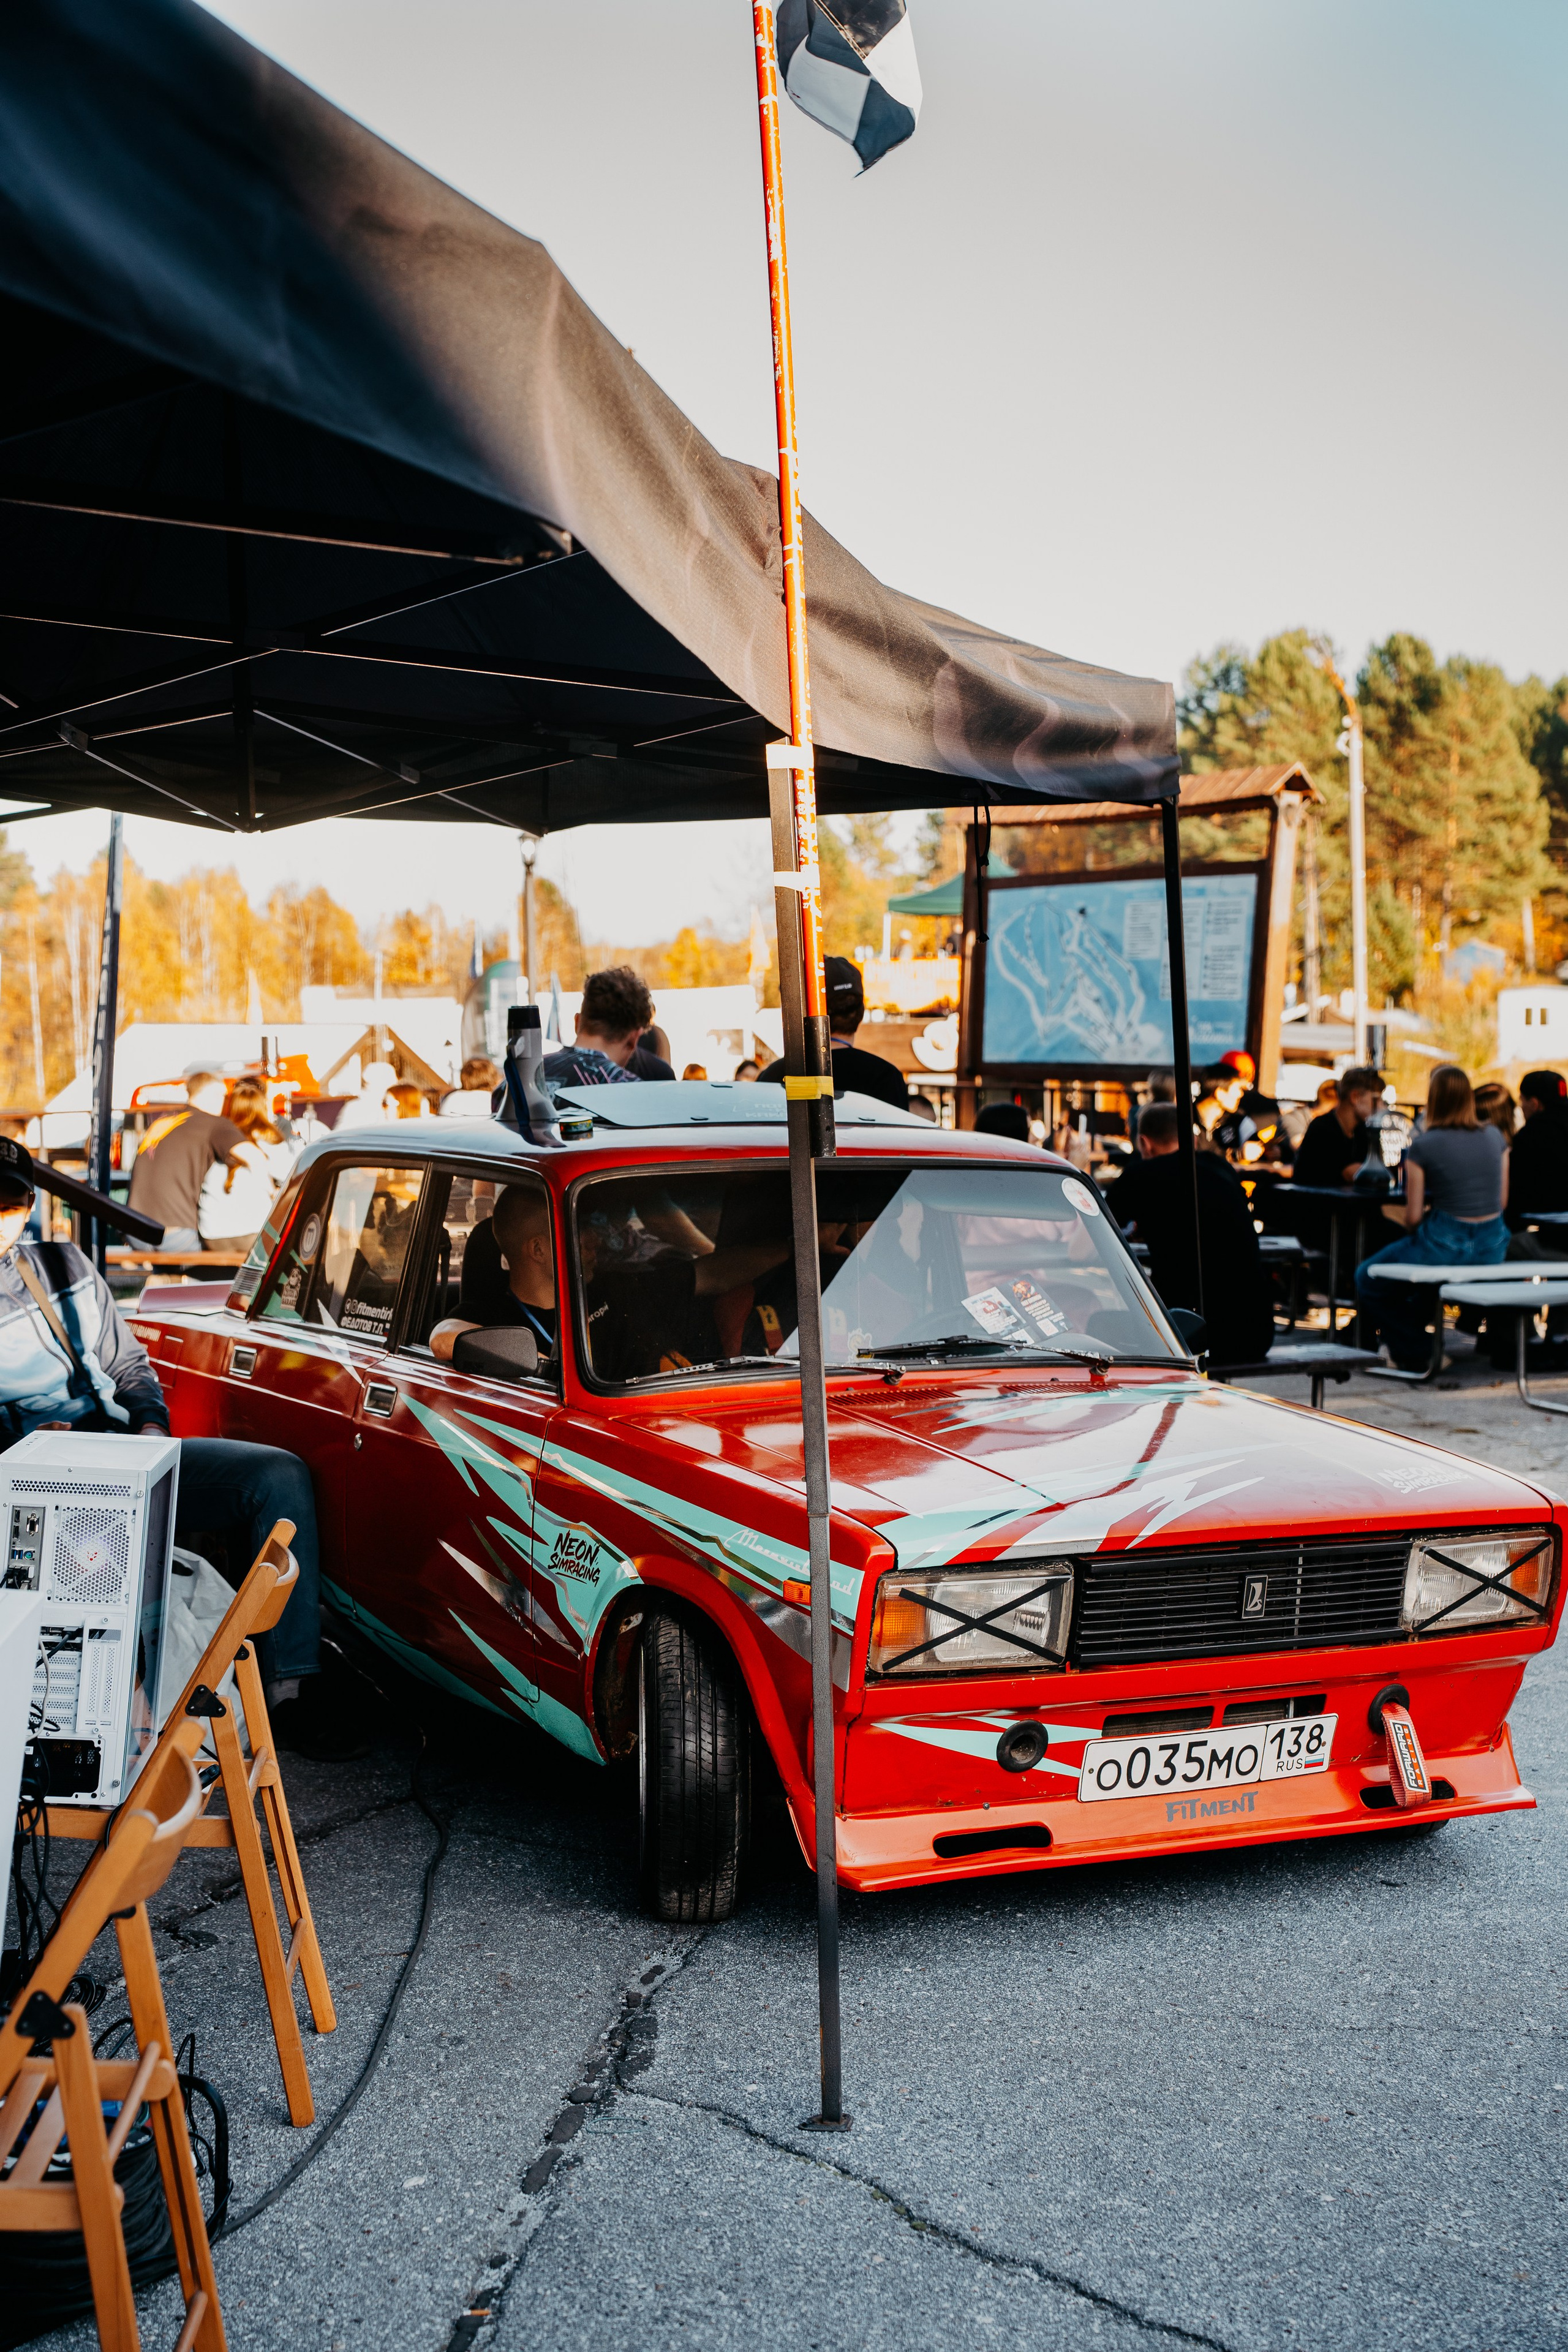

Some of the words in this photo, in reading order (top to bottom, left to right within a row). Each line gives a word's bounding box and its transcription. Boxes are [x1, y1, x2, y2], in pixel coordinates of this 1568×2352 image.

[341, 1316, 373, 1332] ФЕДОТОВ
[554, 1529, 601, 1566] NEON
[548, 1552, 601, 1588] SIMRACING
[1270, 1724, 1324, 1760] 138
[1395, 1724, 1417, 1787] FORWARD
[1403, 1727, 1423, 1785] RACING
[1276, 1758, 1303, 1772] RUS
